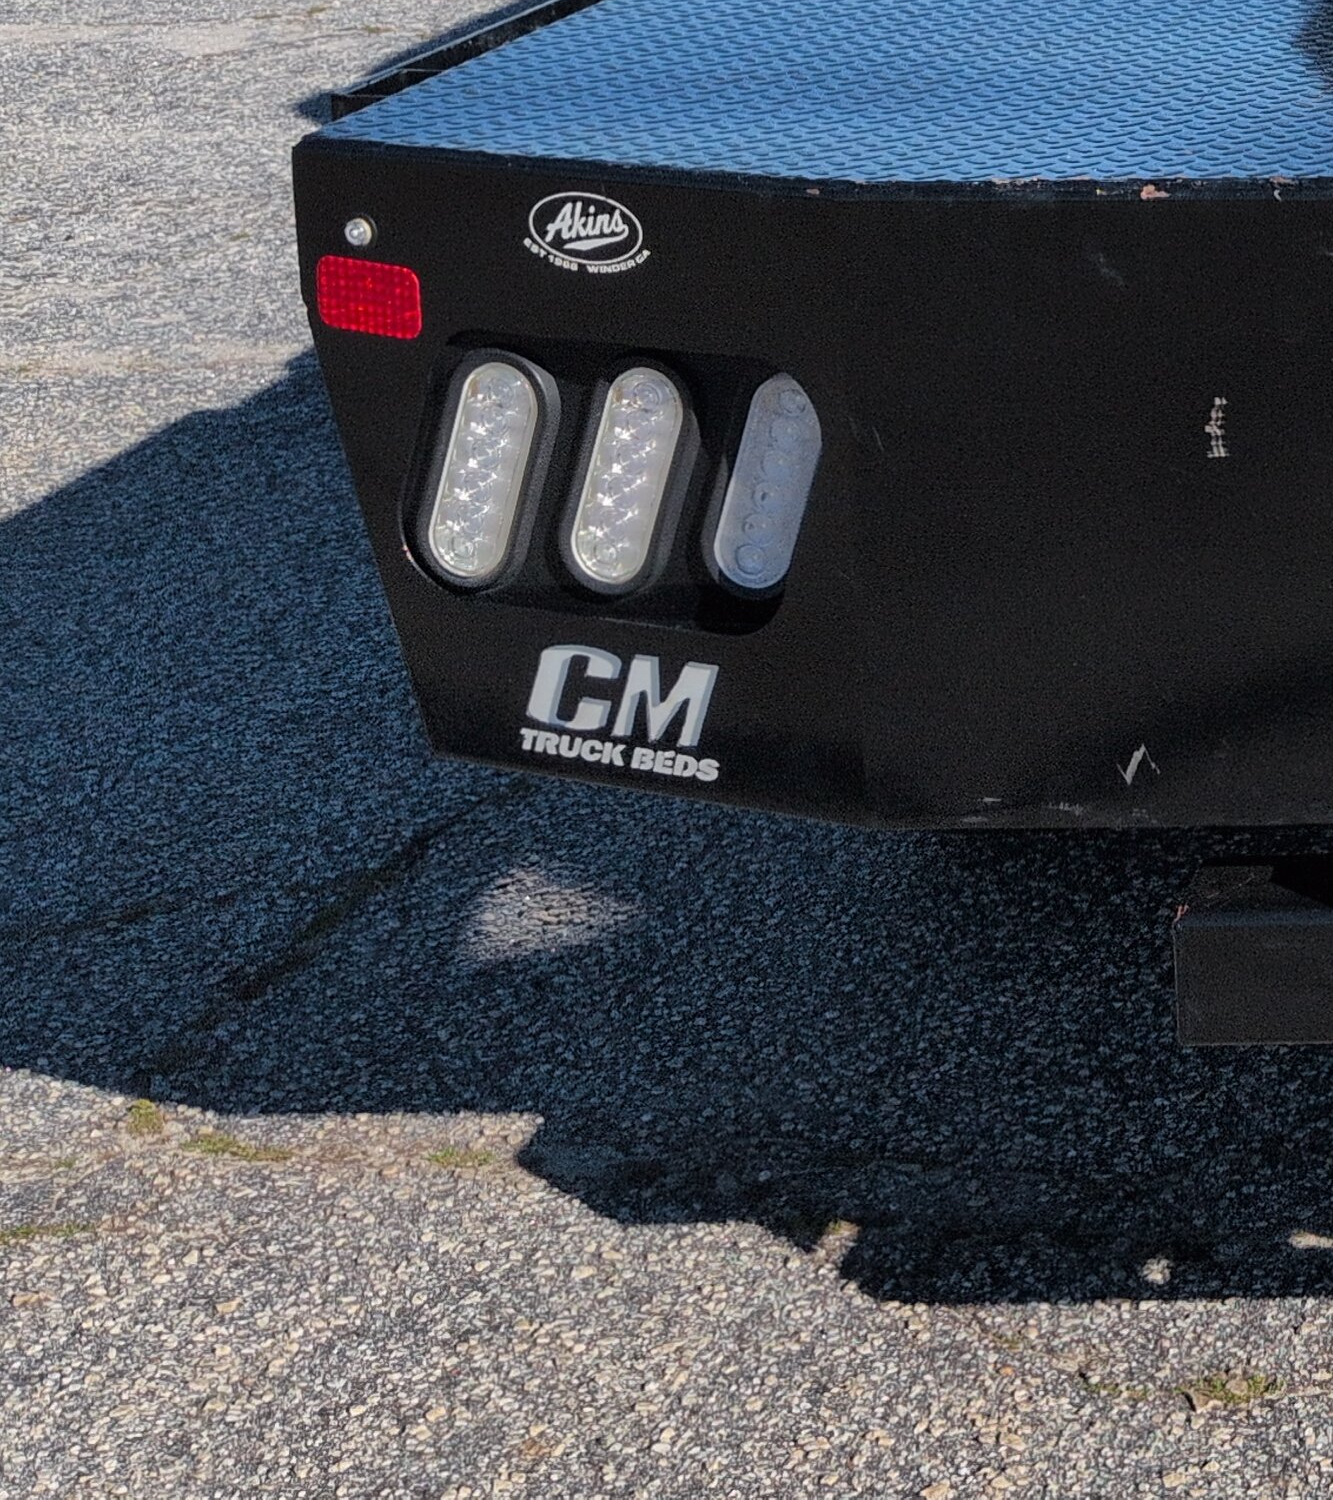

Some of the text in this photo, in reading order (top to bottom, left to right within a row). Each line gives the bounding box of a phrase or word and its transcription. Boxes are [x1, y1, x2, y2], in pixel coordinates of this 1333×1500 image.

[545, 201, 630, 243] Akins
[586, 260, 637, 274] WINDER
[525, 644, 720, 748] CM
[520, 727, 721, 783] TRUCK BEDS
